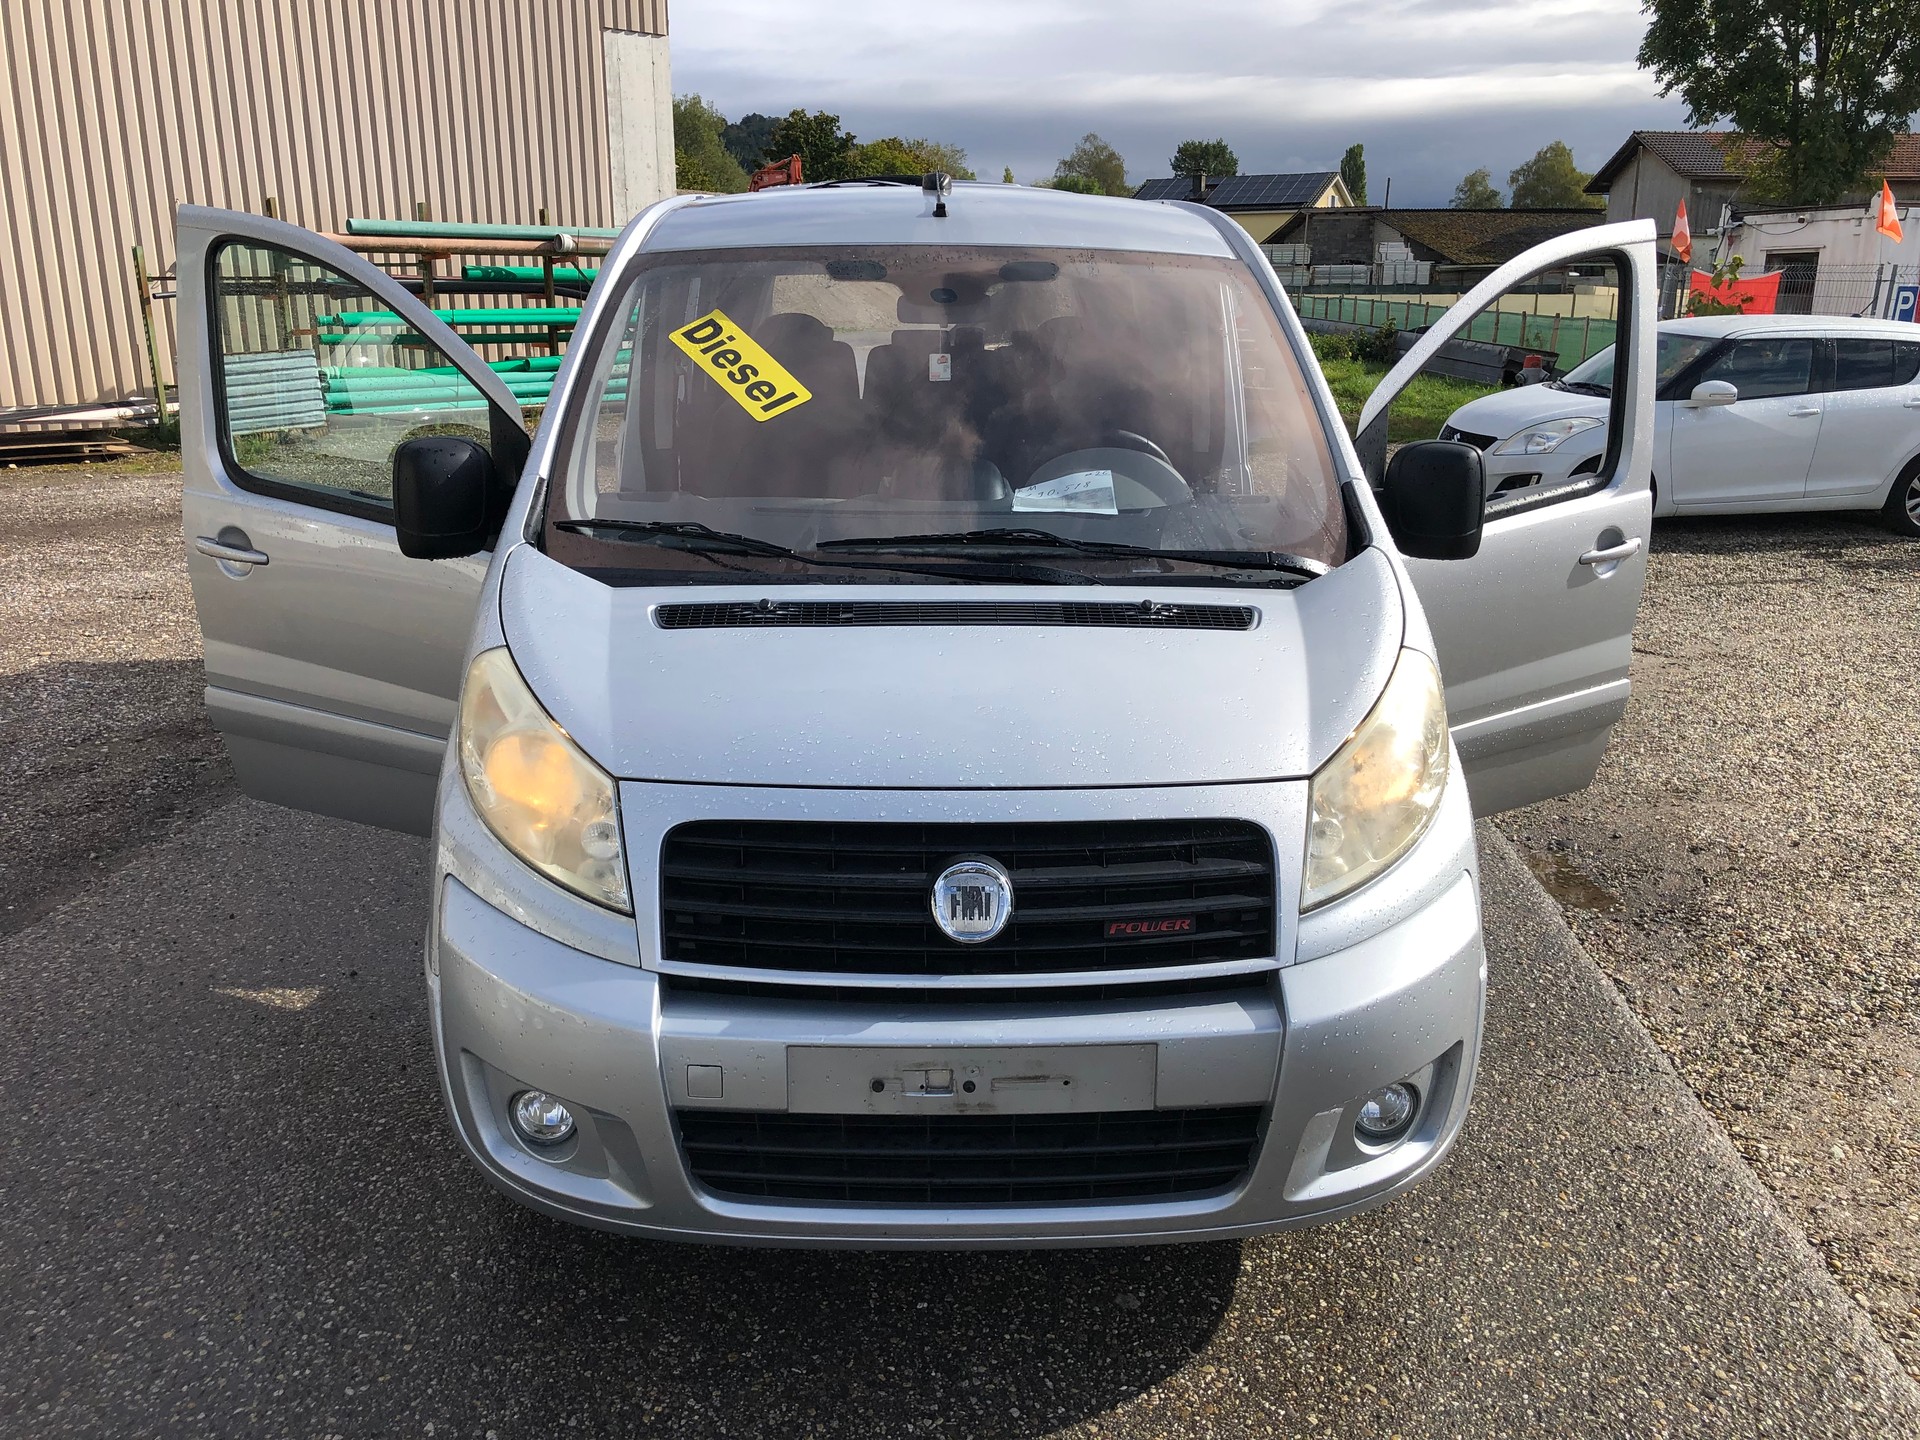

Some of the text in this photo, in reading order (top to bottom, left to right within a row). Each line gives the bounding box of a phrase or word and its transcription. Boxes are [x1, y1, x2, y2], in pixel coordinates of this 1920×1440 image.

[1894, 291, 1915, 320] P
[681, 318, 798, 413] Diesel
[950, 885, 993, 920] FIAT
[1109, 919, 1191, 935] POWER
